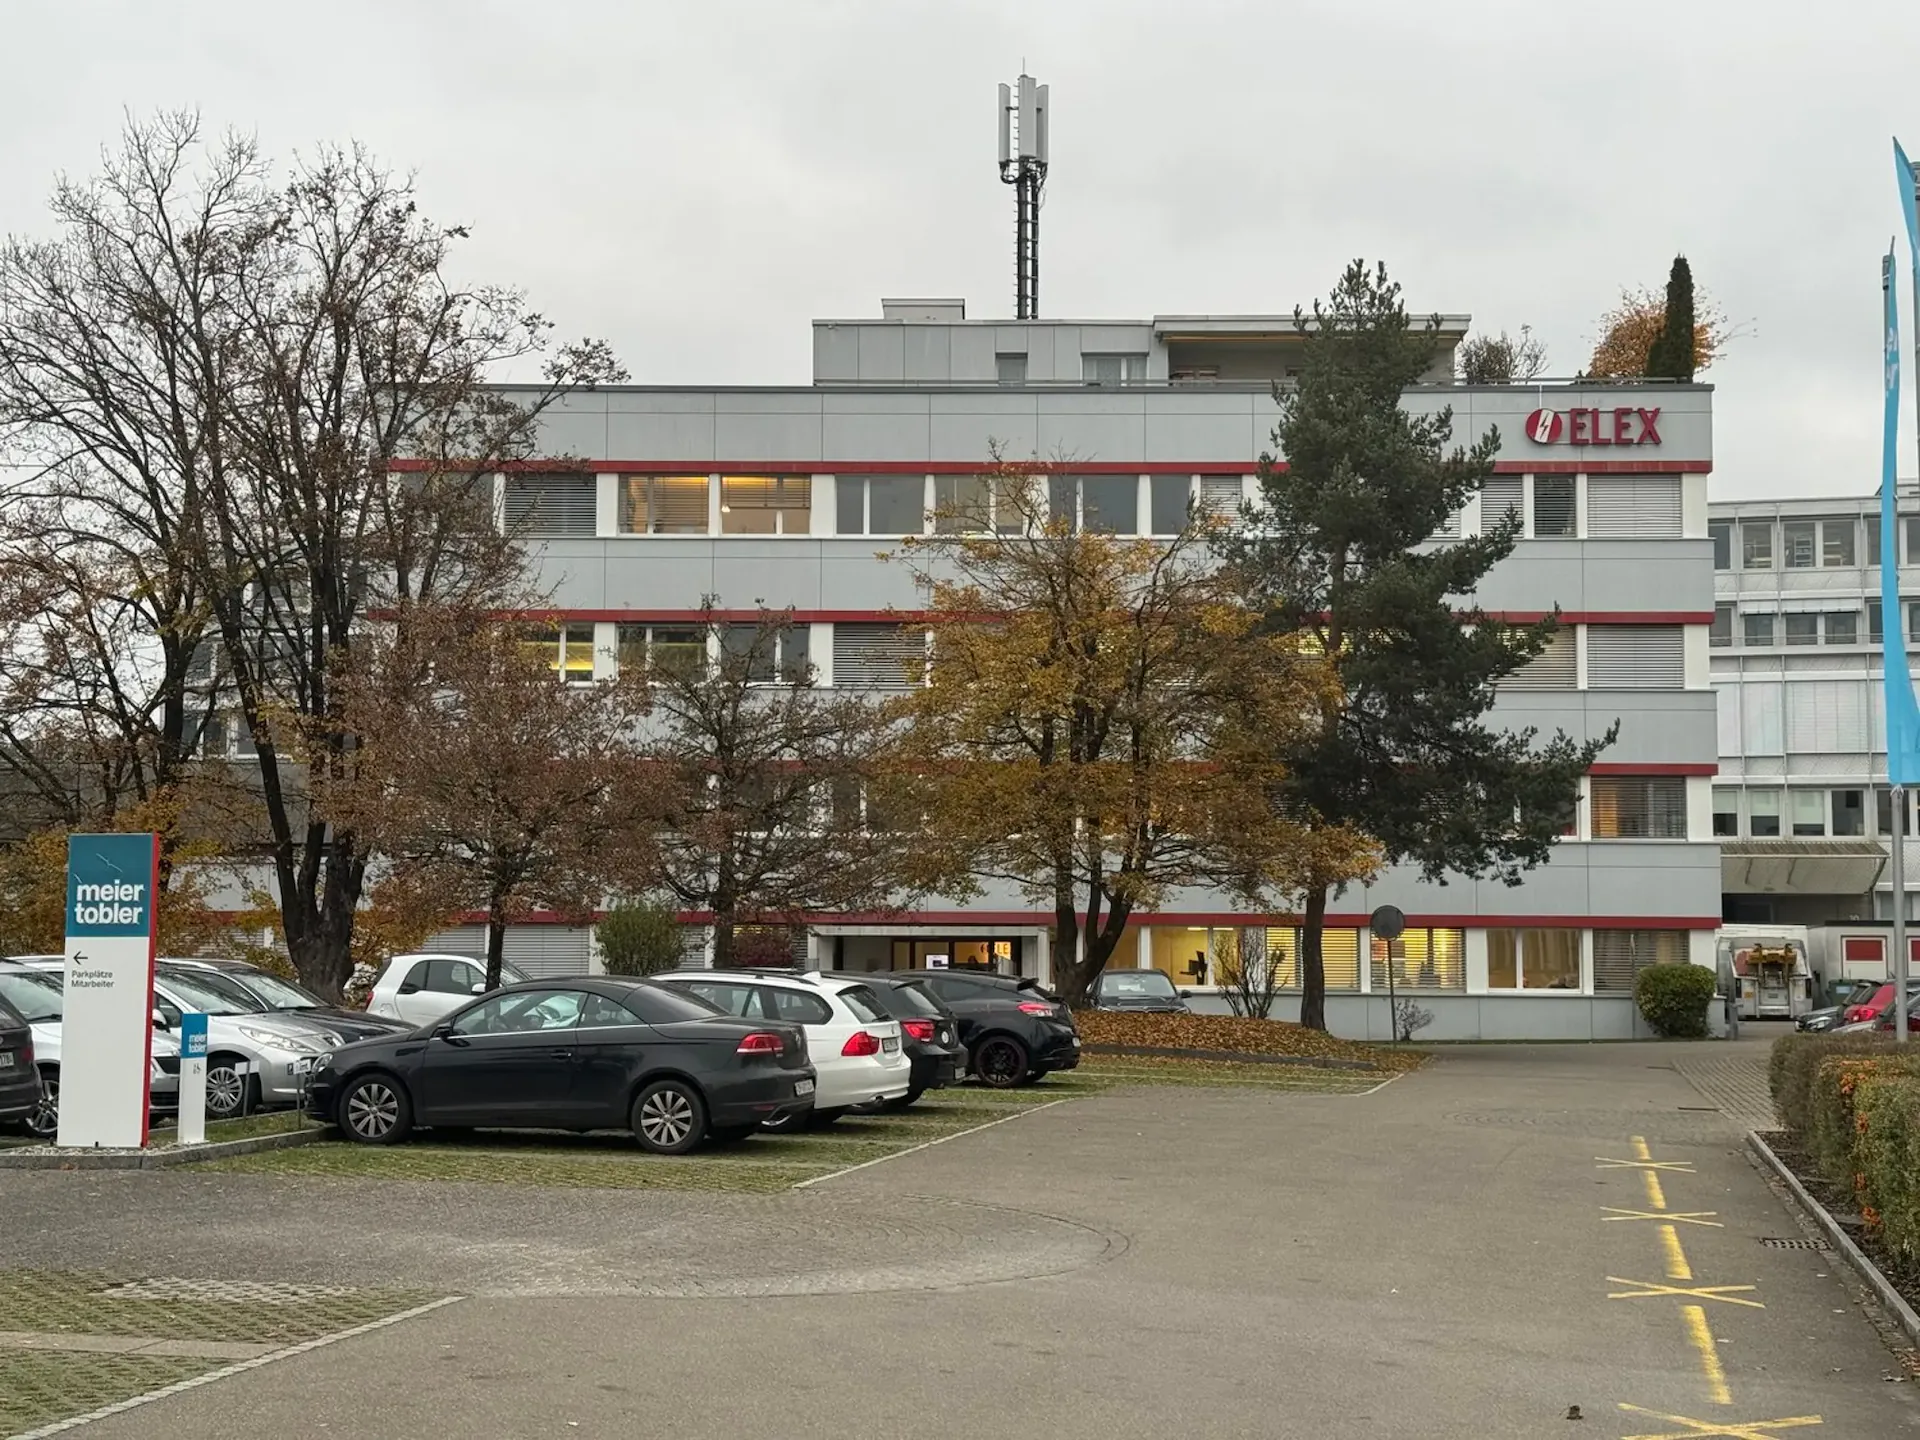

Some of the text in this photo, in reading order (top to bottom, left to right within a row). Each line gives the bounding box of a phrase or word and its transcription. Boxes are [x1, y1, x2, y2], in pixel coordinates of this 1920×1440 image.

[1570, 407, 1662, 445] ELEX
[77, 879, 145, 902] meier
[74, 902, 143, 925] tobler
[71, 979, 115, 988] Mitarbeiter
[72, 970, 113, 979] Parkplätze
